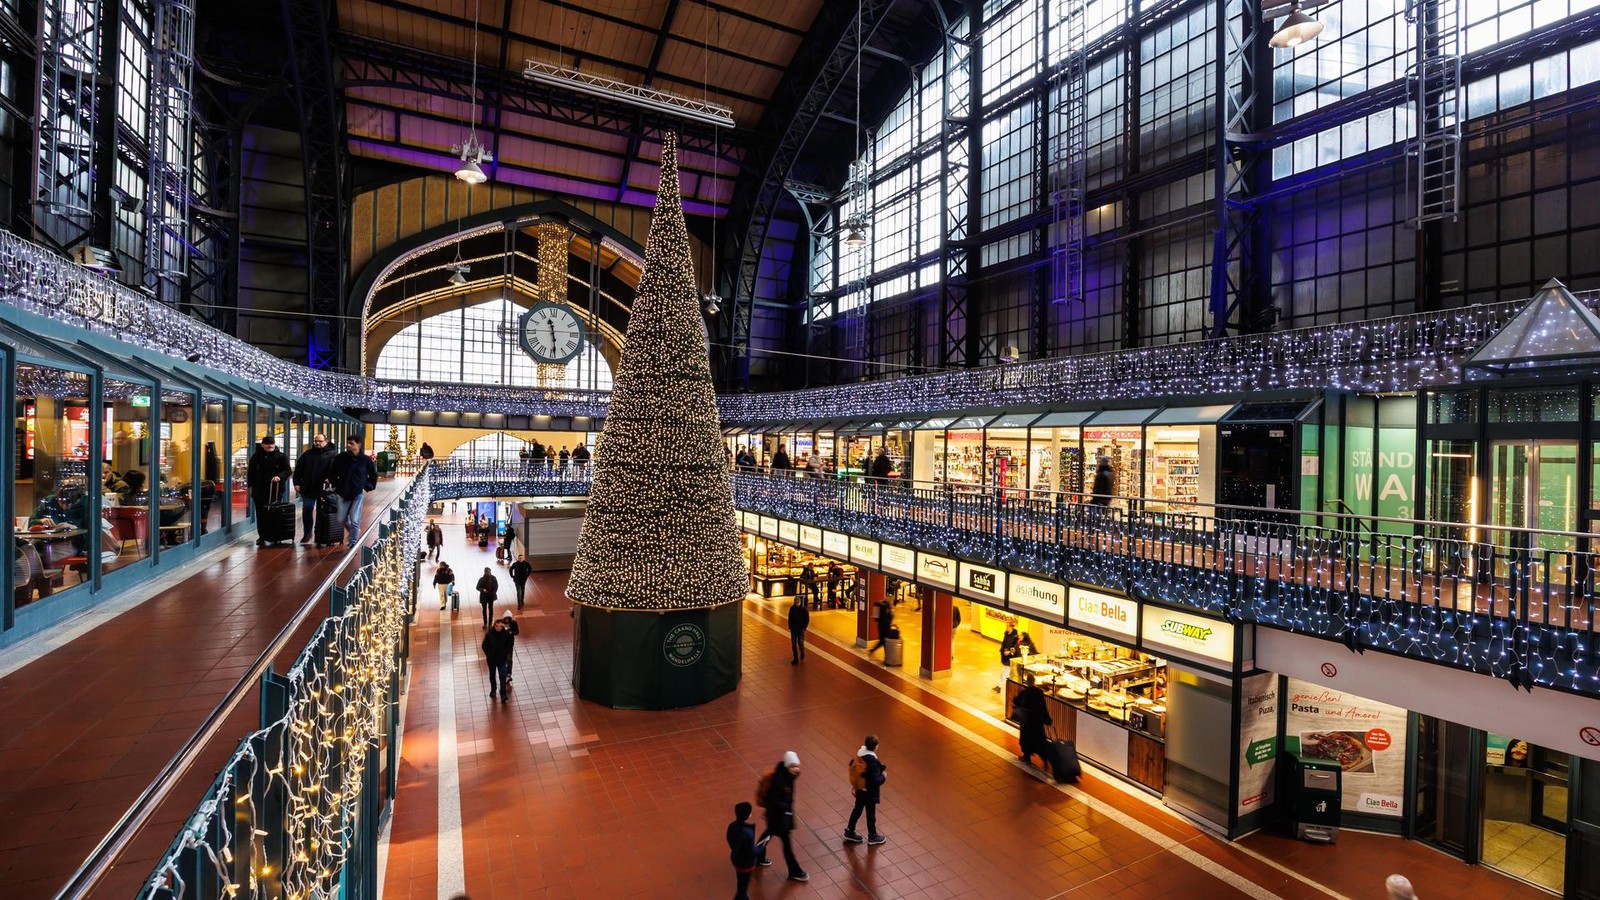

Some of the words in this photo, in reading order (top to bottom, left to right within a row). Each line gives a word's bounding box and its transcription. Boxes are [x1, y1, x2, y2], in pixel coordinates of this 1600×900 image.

[1015, 584, 1058, 605] asiahung
[1078, 596, 1099, 614] Ciao
[1101, 602, 1127, 622] Bella
[667, 633, 675, 643] THE
[674, 626, 693, 634] GRAND
[692, 629, 702, 640] HALL
[1161, 620, 1212, 640] SUBWAY
[668, 650, 701, 664] WANDELHALLE
[1293, 690, 1342, 703] genießen!
[1291, 703, 1320, 714] Pasta
[1325, 707, 1343, 718] und
[1344, 706, 1380, 720] Amore!
[1366, 797, 1380, 806] Ciao
[1381, 799, 1398, 809] Bella
